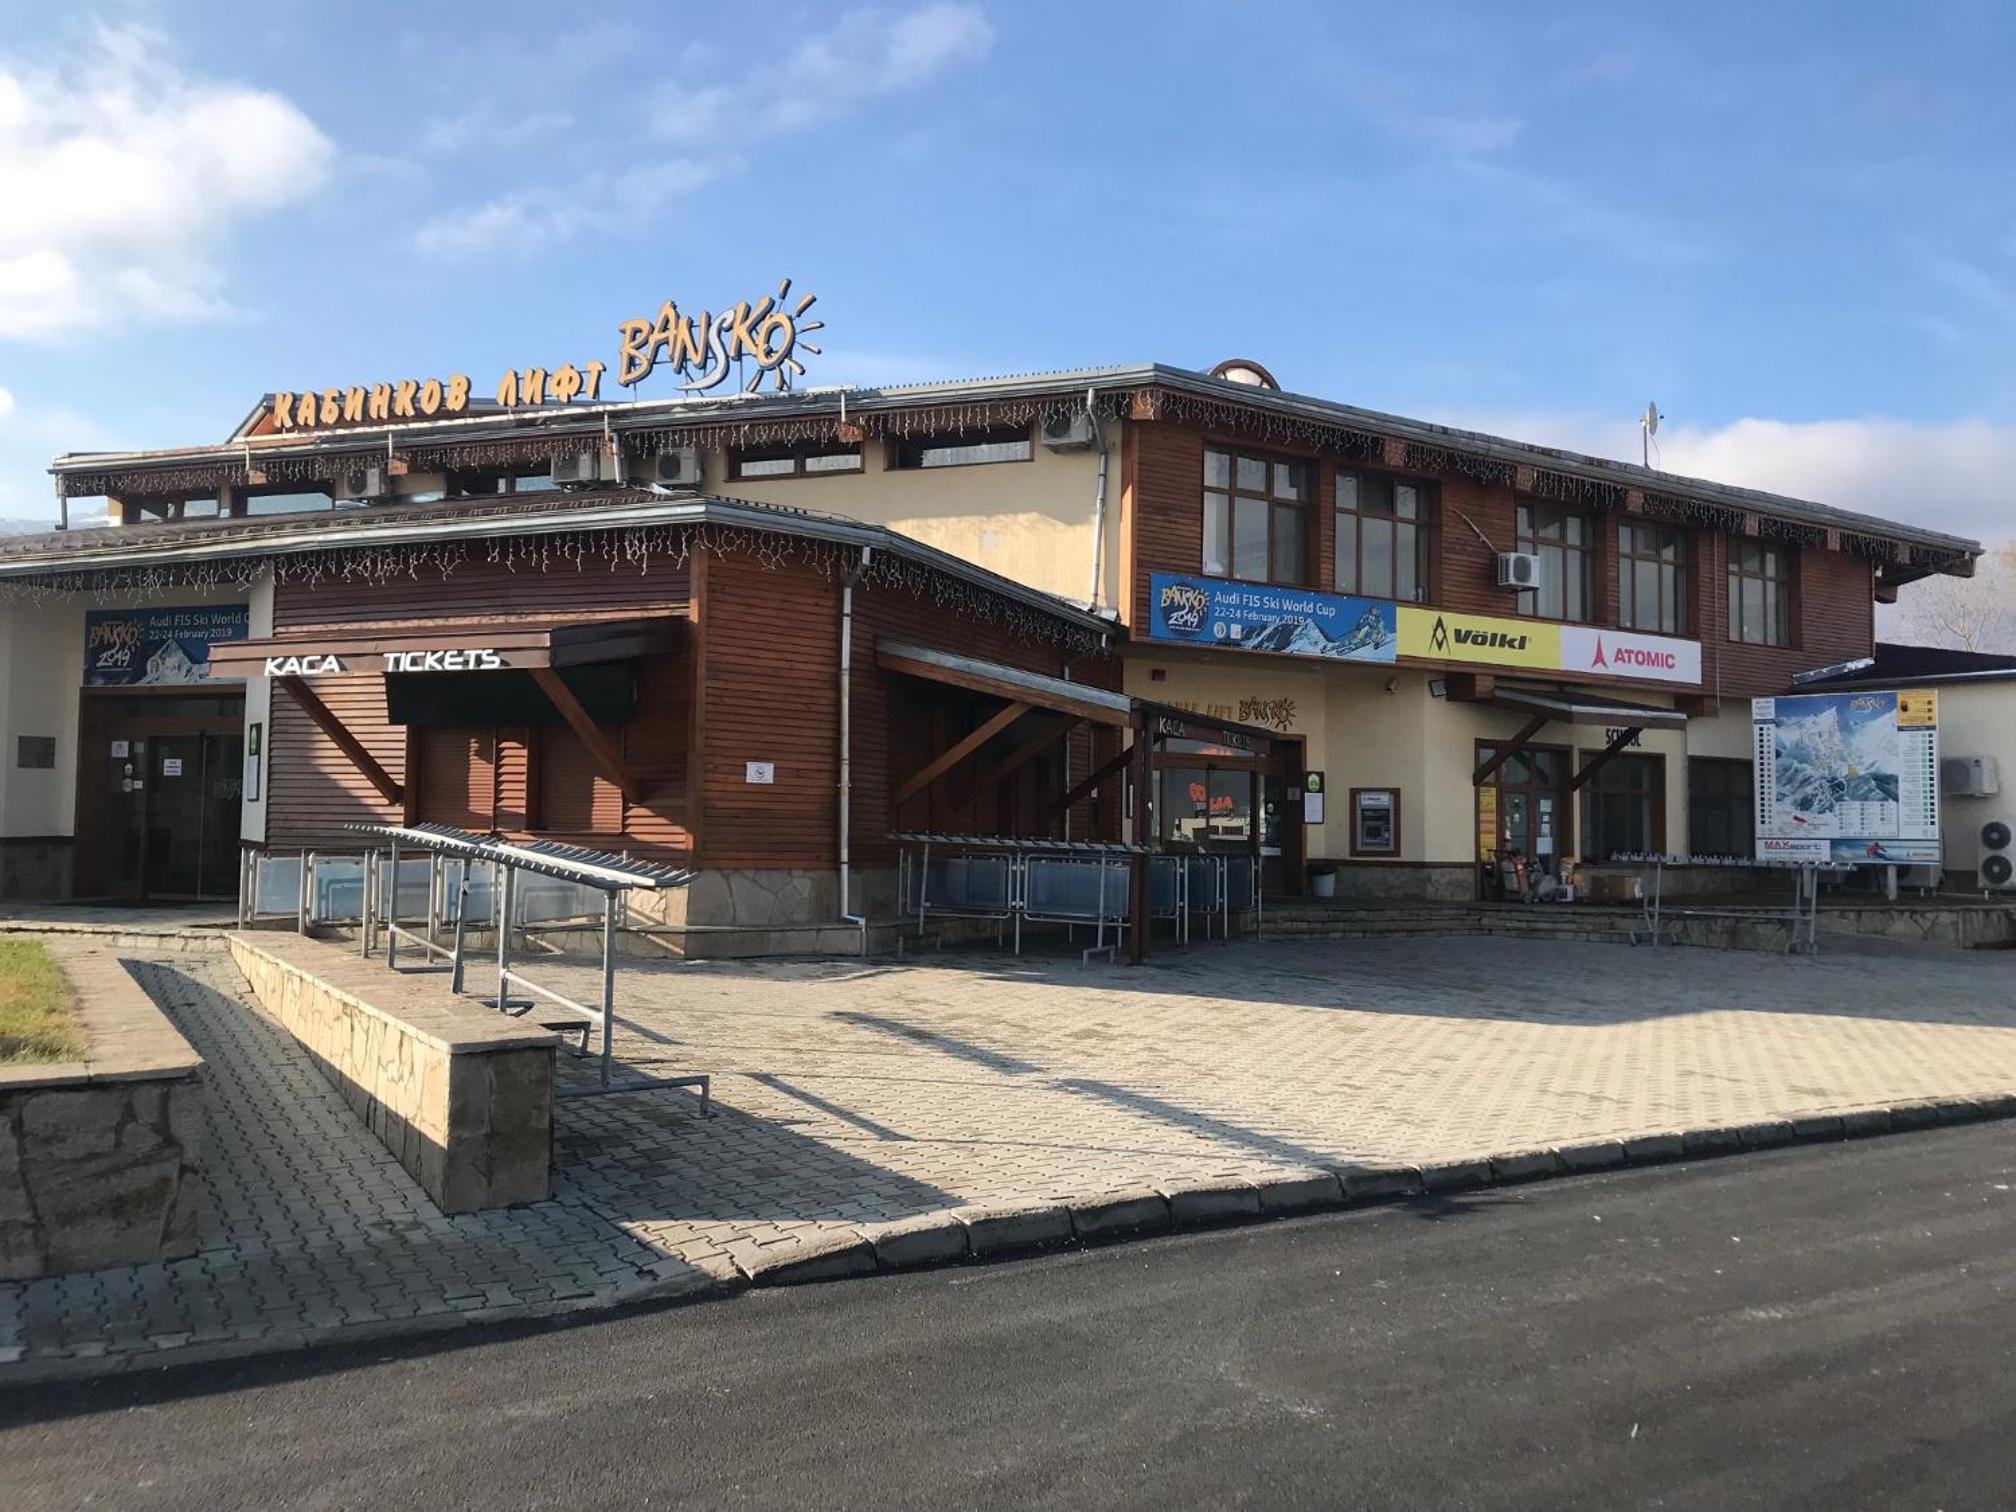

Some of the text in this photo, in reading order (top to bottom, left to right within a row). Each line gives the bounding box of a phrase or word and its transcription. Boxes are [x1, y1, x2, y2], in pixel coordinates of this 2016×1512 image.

[619, 296, 796, 391] BANSKO
[273, 361, 606, 428] КАБИНКОВ ЛИФТ
[1214, 591, 1336, 618] Audi FIS Ski World Cup
[150, 615, 171, 627] Audi
[174, 614, 191, 626] FIS
[193, 613, 209, 626] Ski
[210, 612, 242, 625] World
[1168, 612, 1199, 628] 2019
[1214, 607, 1305, 626] 22-24 February 2019
[150, 628, 232, 641] 22-24 February 2019
[1454, 628, 1527, 651] Völkl
[96, 648, 131, 668] 2019
[384, 649, 502, 673] TICKETS
[1613, 648, 1676, 669] ATOMIC
